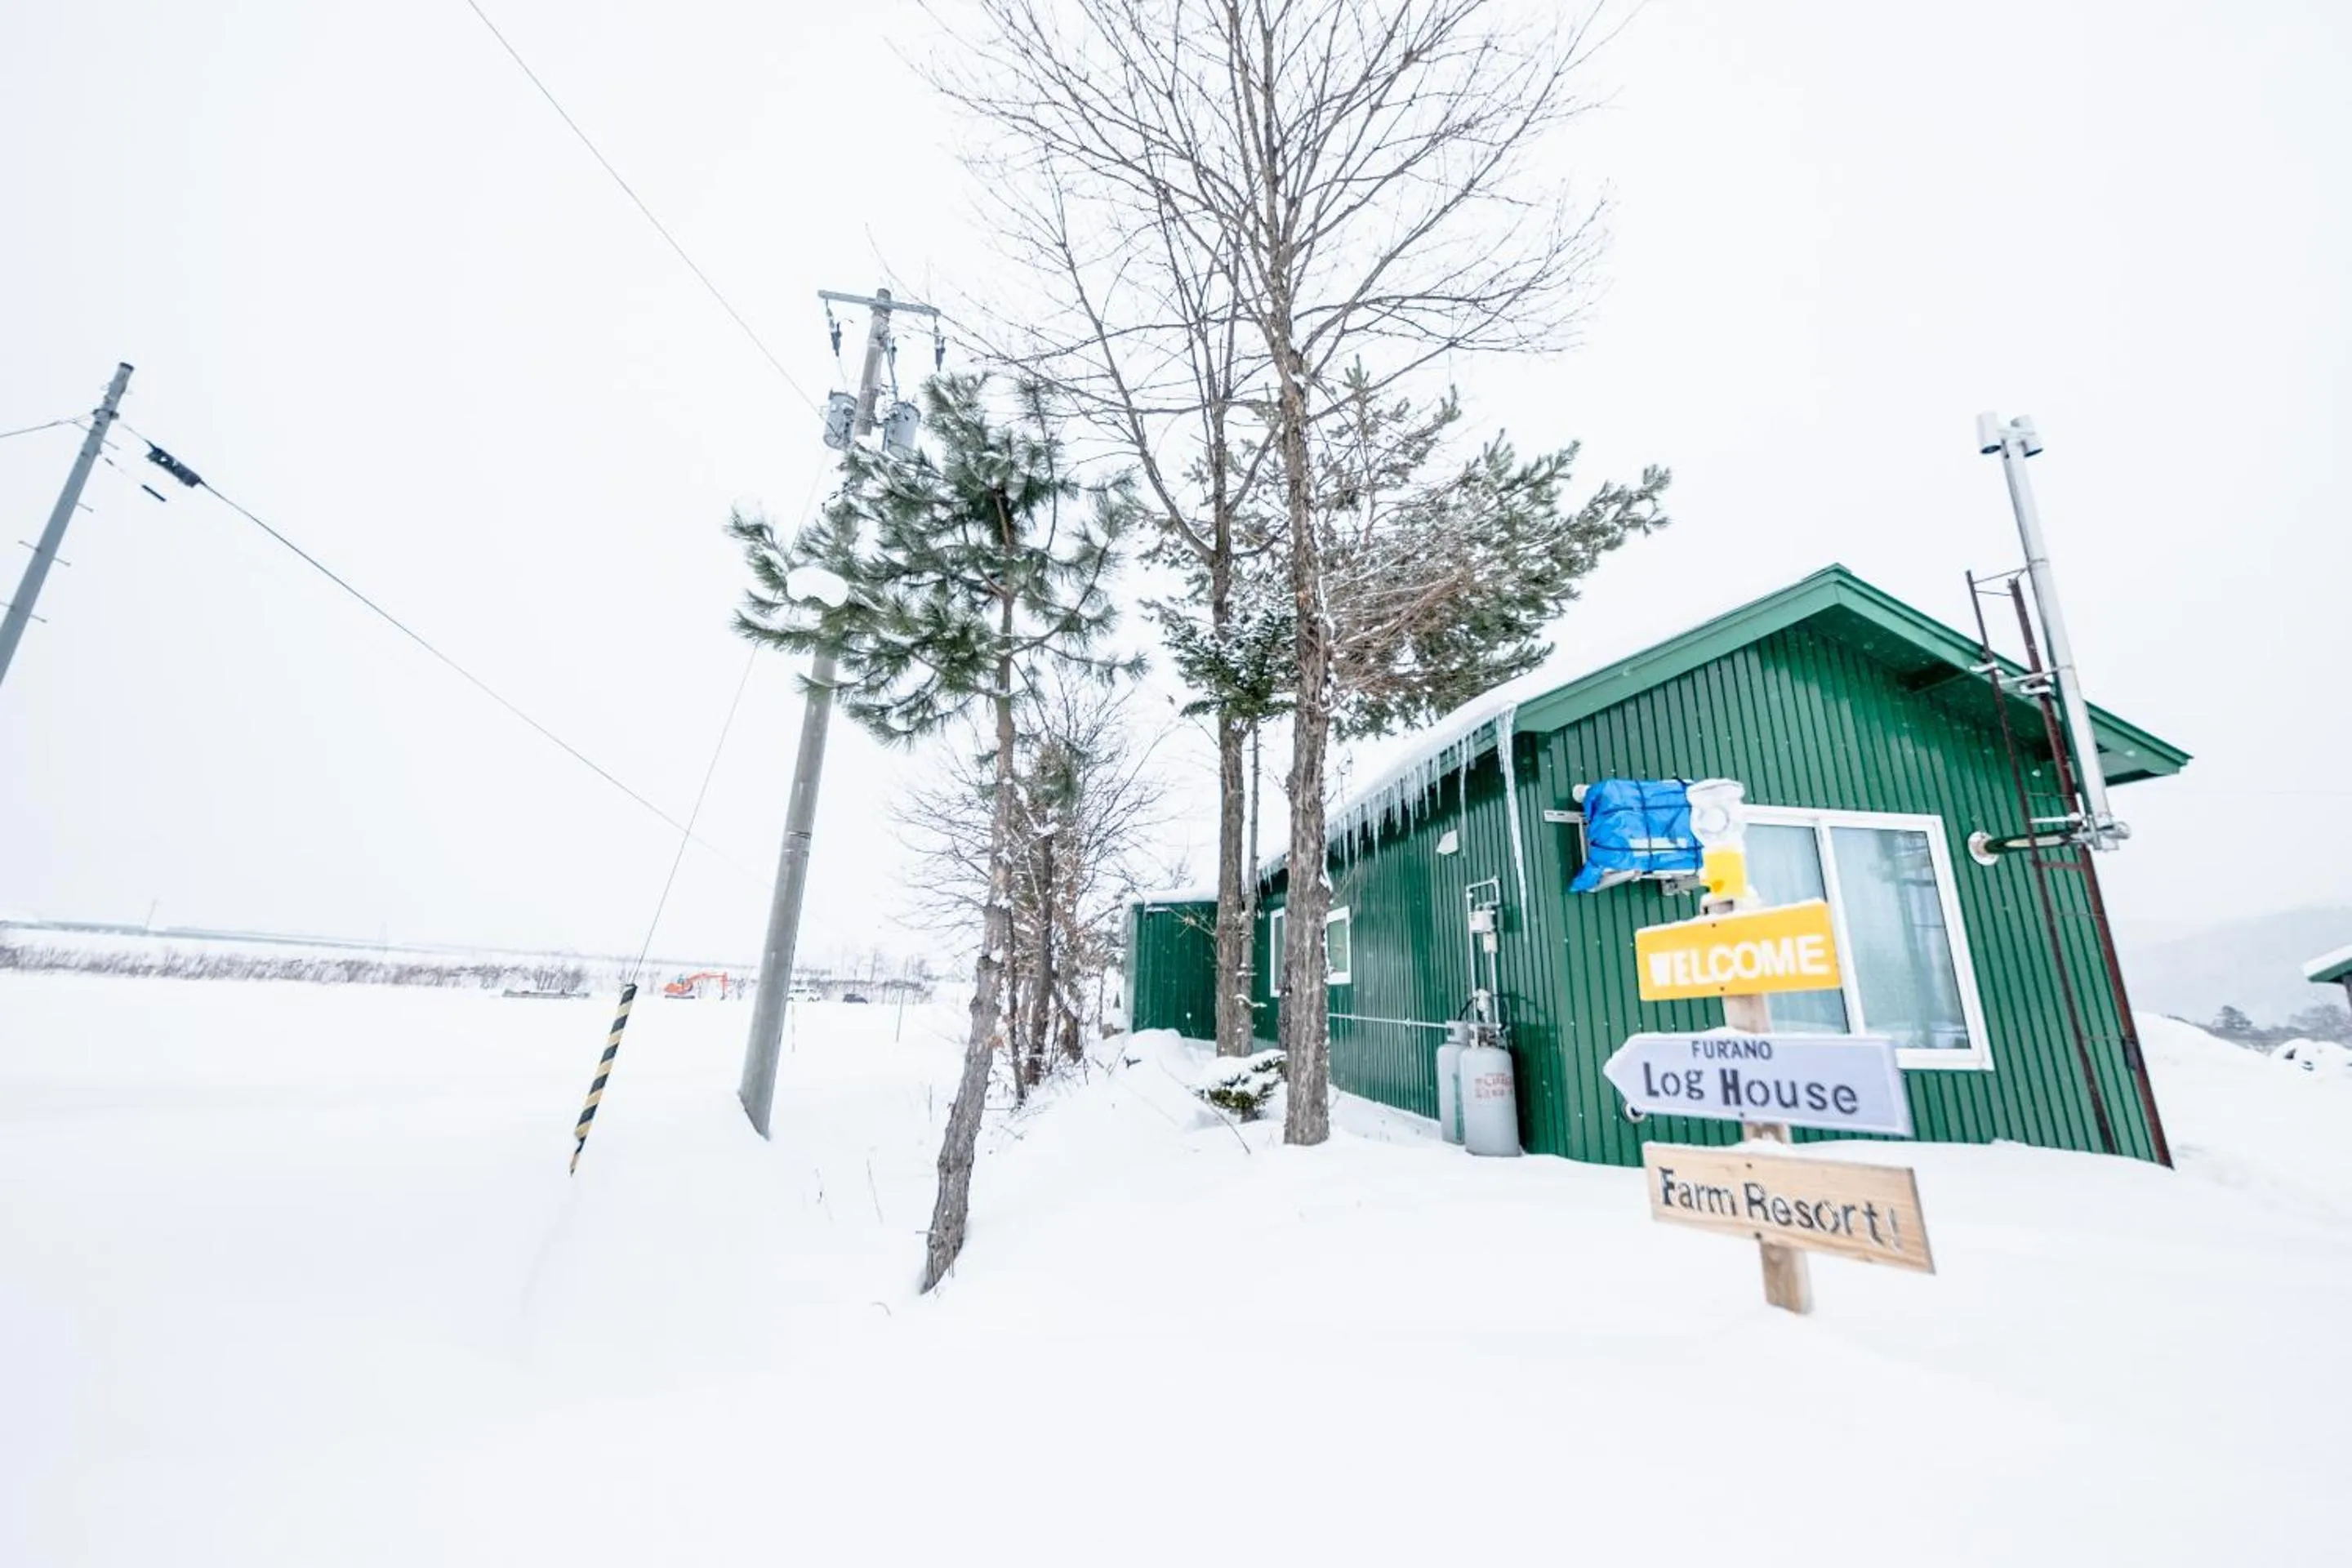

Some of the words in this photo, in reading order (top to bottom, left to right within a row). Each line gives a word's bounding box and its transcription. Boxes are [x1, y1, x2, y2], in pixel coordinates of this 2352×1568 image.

[1648, 934, 1830, 987] WELCOME
[1691, 1040, 1773, 1060] FURANO
[1643, 1062, 1704, 1101] Log
[1720, 1068, 1859, 1114] House
[1658, 1166, 1737, 1217] Farm
